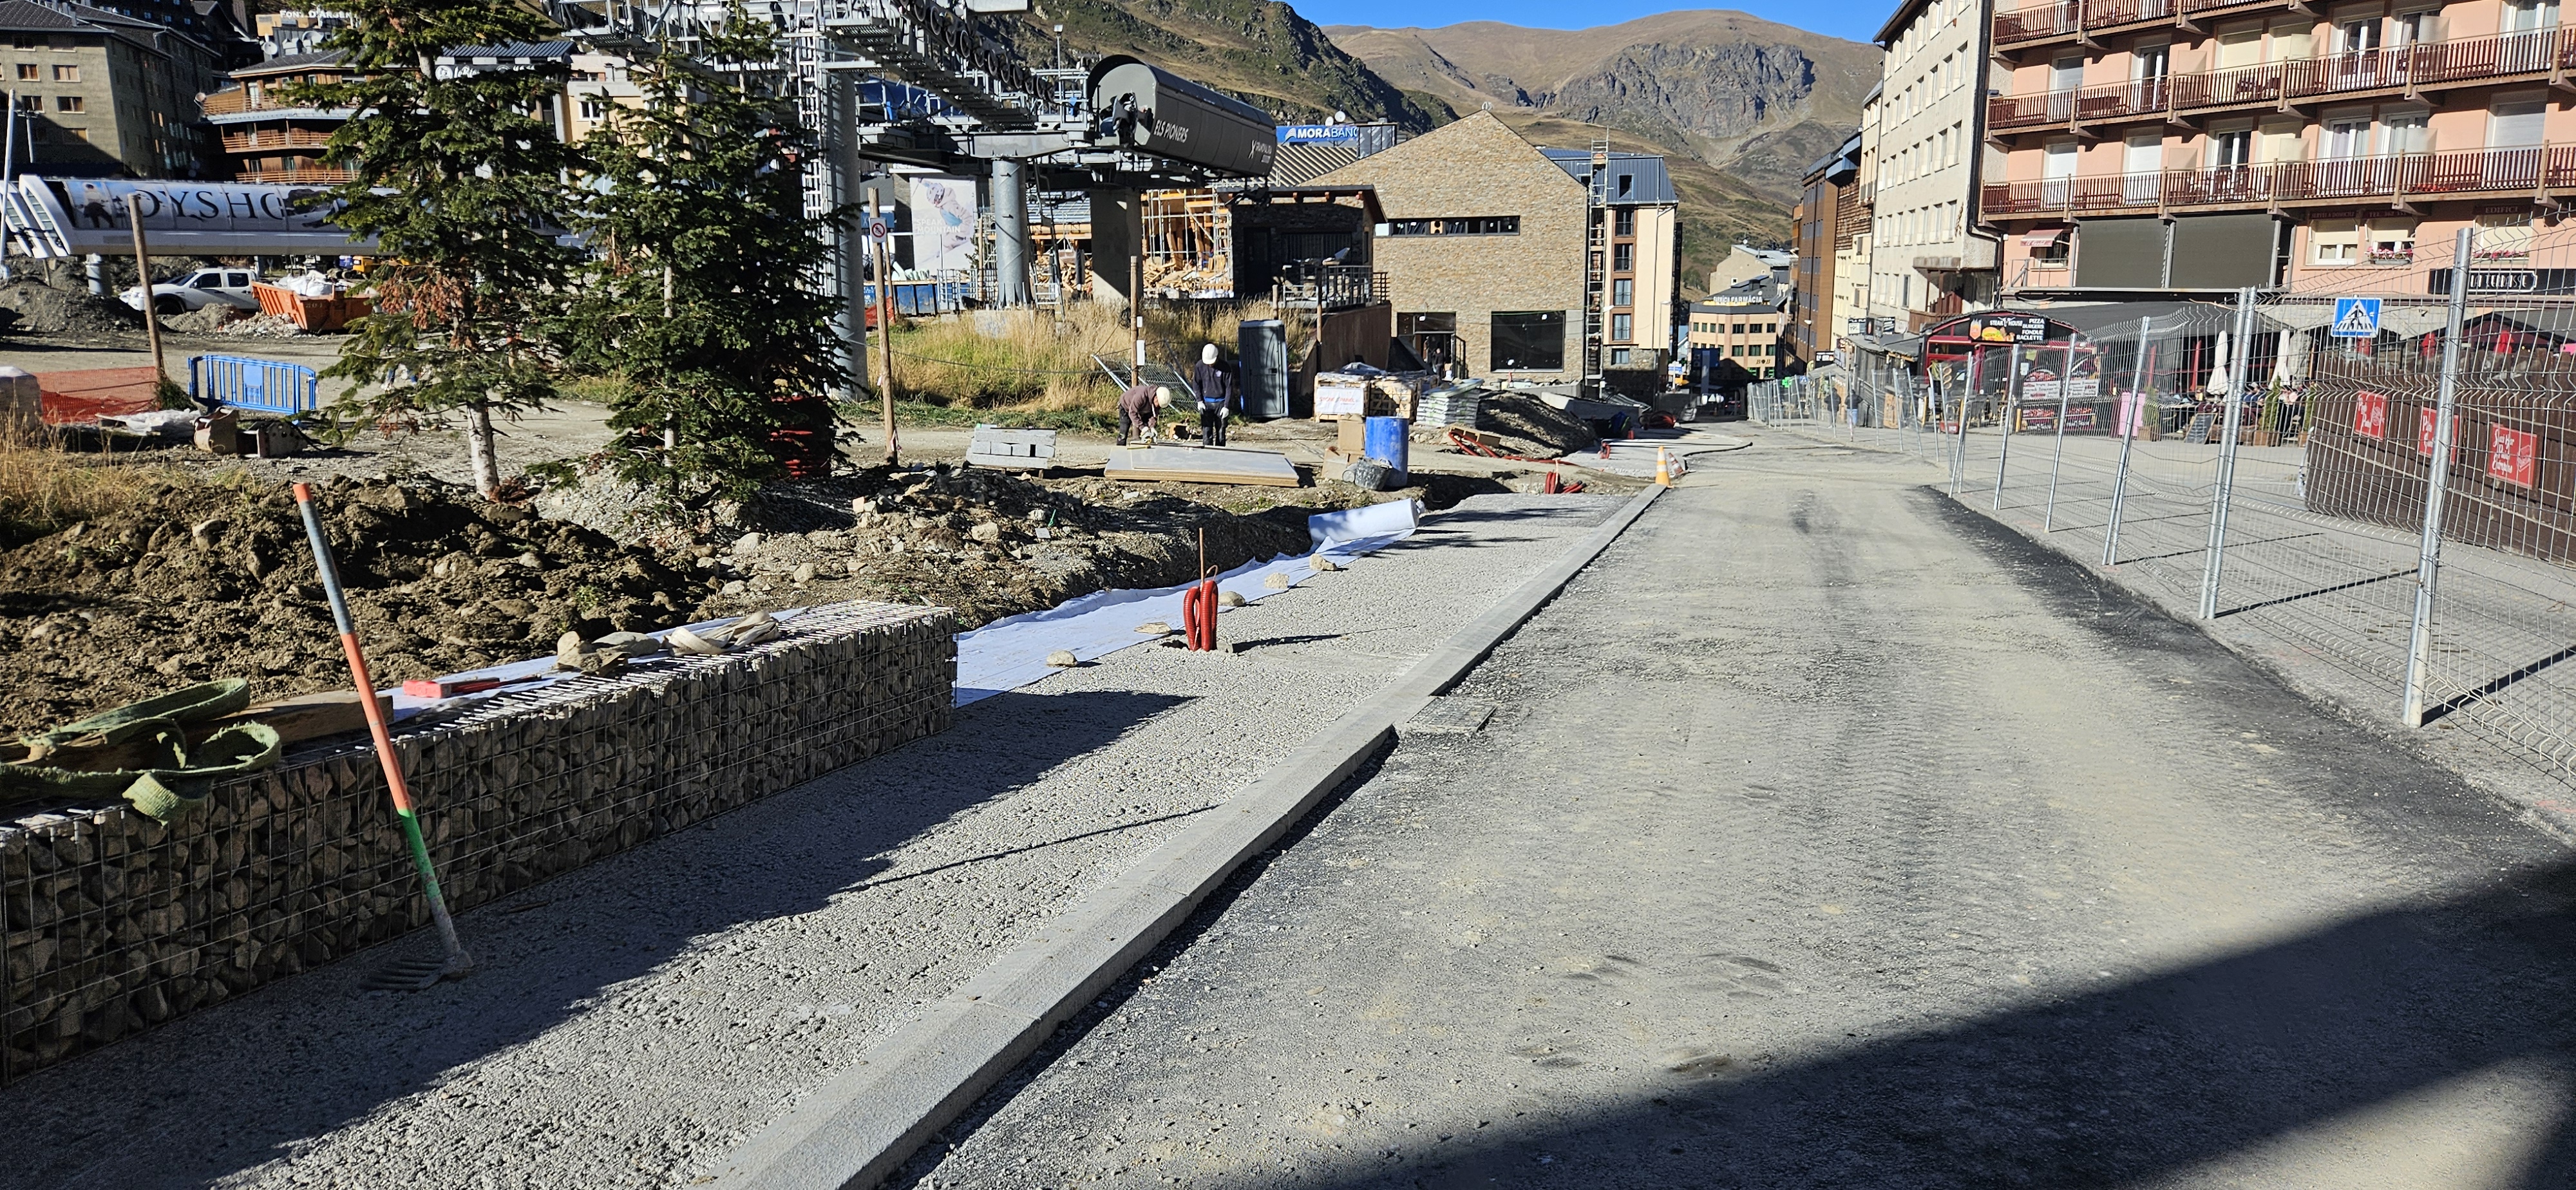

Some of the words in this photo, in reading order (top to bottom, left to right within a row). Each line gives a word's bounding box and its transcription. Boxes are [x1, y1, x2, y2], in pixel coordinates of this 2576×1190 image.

[308, 10, 359, 18] D'ARGEN
[1153, 120, 1165, 137] ELS
[1163, 122, 1189, 143] PIONERS
[1730, 295, 1763, 303] FARMÀCIA
